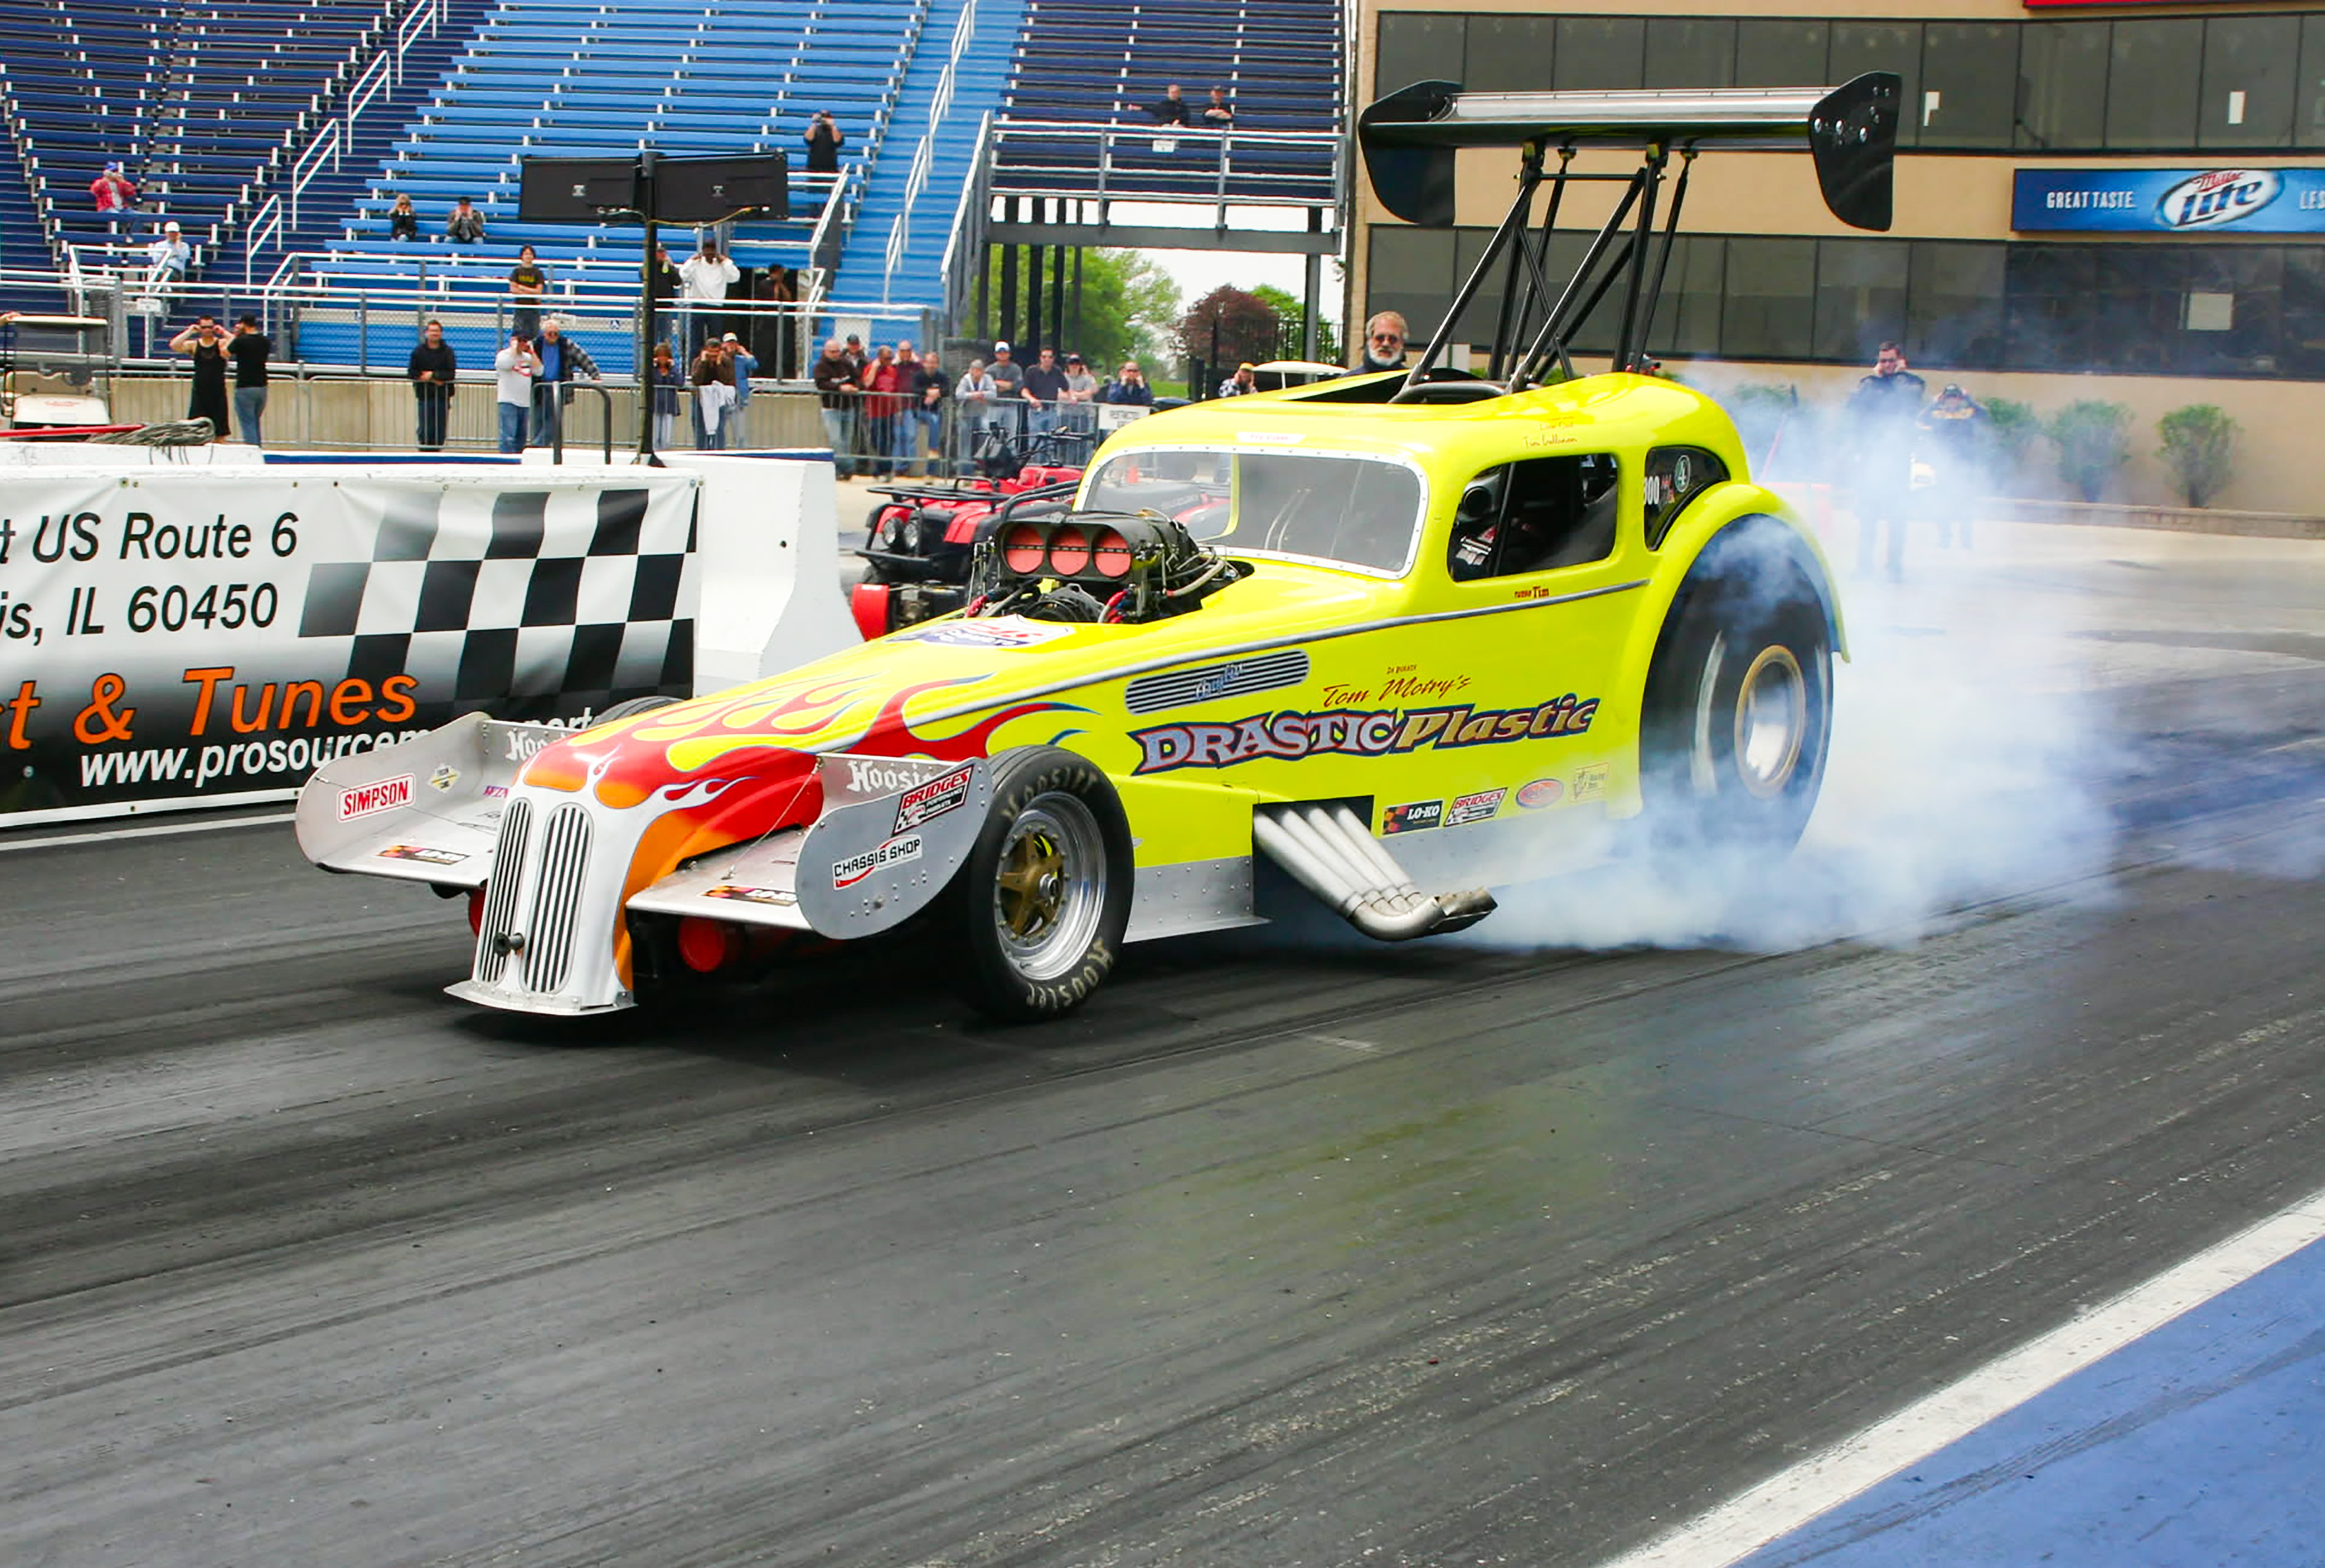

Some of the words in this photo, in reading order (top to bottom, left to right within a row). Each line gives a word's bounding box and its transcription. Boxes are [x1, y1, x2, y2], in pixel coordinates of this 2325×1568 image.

[2047, 191, 2091, 209] GREAT
[2180, 181, 2262, 226] Lite
[32, 512, 101, 563] US
[119, 512, 252, 560] Route
[271, 511, 299, 557] 6
[66, 587, 105, 635] IL
[128, 582, 278, 633] 60450
[0, 680, 41, 750] t
[73, 673, 136, 745] &
[181, 666, 420, 737] Tunes
[1323, 684, 1369, 708] Tom
[1128, 709, 1399, 775] DRASTIC
[1388, 692, 1602, 755] Plastic
[344, 780, 409, 815] SIMPSON
[902, 770, 969, 809] BRIDGES
[1407, 805, 1440, 820] LO-KO
[834, 849, 886, 877] CHASSIS
[890, 839, 921, 859] SHOP
